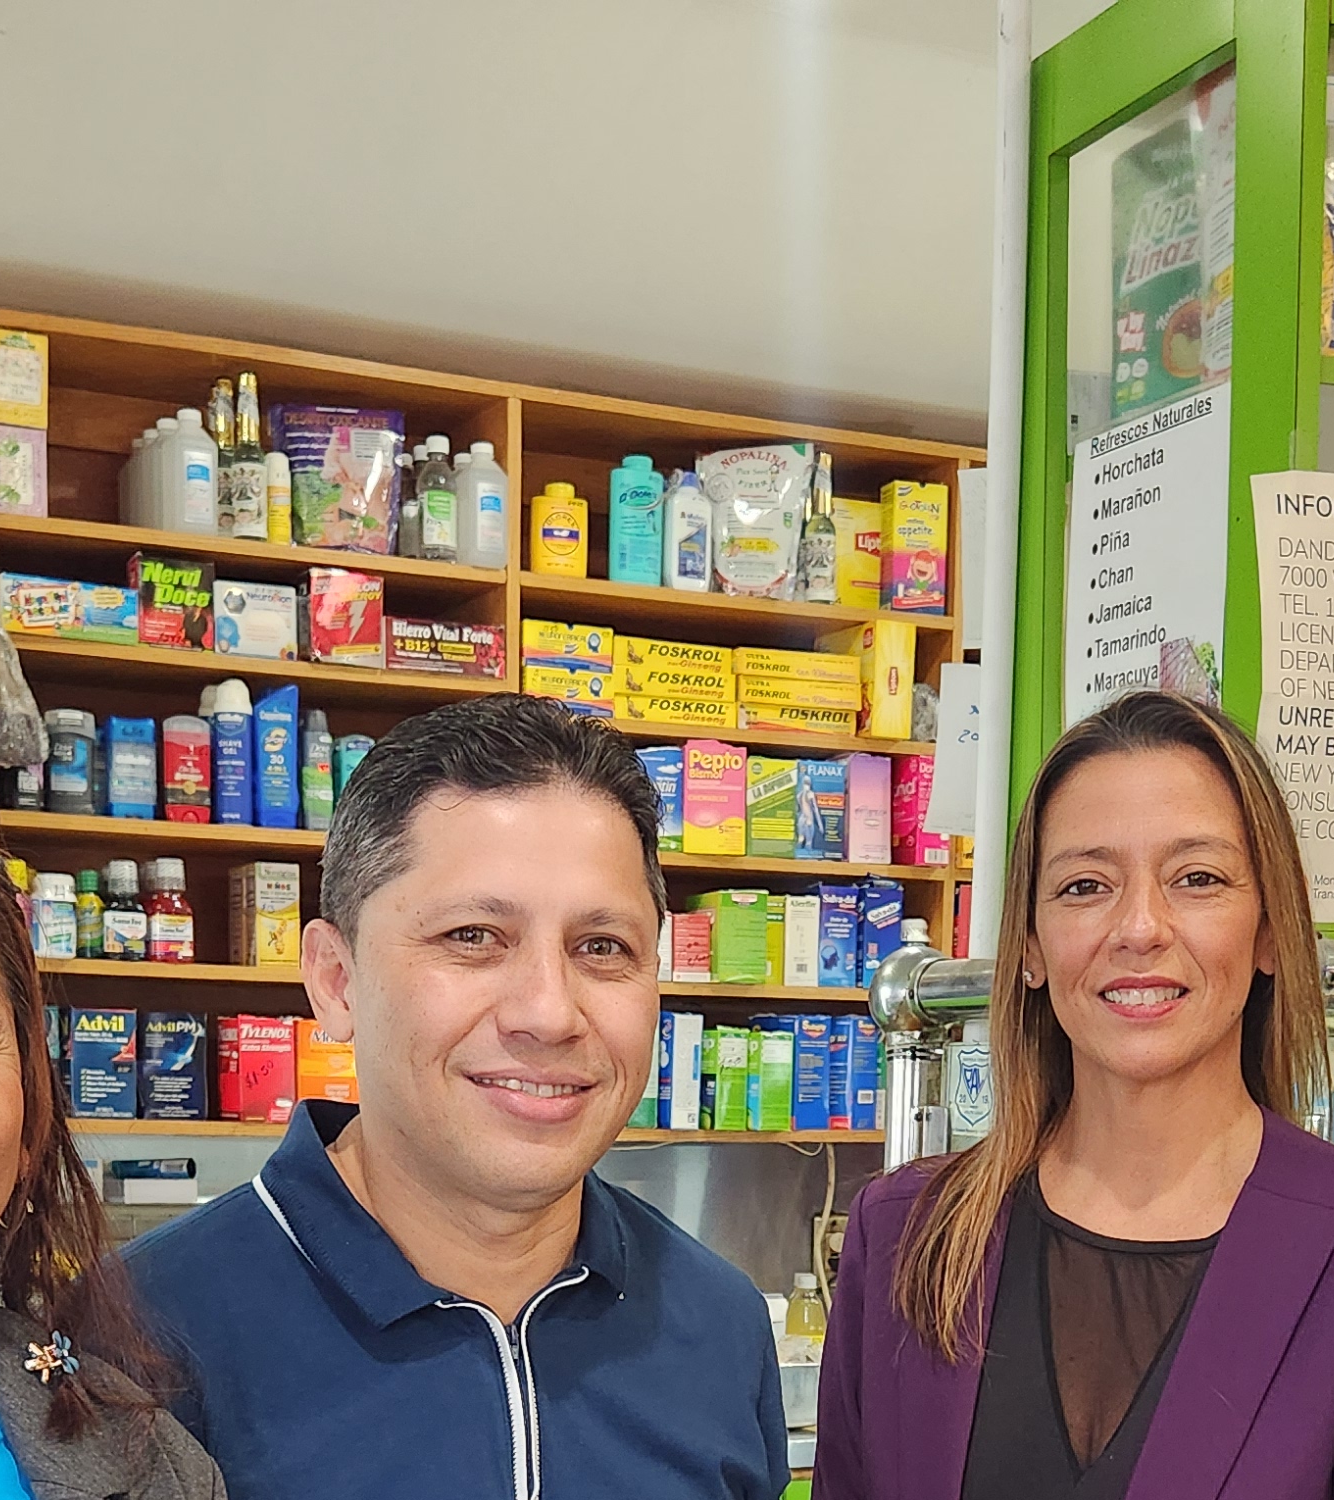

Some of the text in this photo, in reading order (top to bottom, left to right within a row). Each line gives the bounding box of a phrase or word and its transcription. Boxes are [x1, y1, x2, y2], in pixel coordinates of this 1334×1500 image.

[1090, 395, 1213, 458] Refrescos Naturales
[720, 449, 789, 471] NOPALINA
[1102, 447, 1165, 486] Horchata
[1100, 485, 1161, 521] Marañon
[1100, 530, 1130, 556] Piña
[1098, 564, 1134, 590] Chan
[1279, 565, 1328, 589] 7000
[156, 583, 211, 608] Doce
[1279, 593, 1319, 617] TEL.
[1095, 594, 1153, 626] Jamaica
[392, 619, 495, 646] Hierro Vital Forte
[1094, 624, 1167, 659] Tamarindo
[648, 643, 723, 663] FOSKROL
[746, 661, 791, 674] FOSKROL
[1093, 663, 1159, 694] Maracuya
[647, 671, 725, 689] FOSKROL
[1280, 677, 1307, 698] OF
[745, 688, 791, 701] FOSKROL
[648, 698, 727, 716] FOSKROL
[779, 707, 852, 725] FOSKROL
[1275, 733, 1321, 756] MAY
[269, 754, 284, 765] 30
[689, 748, 743, 774] Pepto
[808, 764, 844, 777] FLANAX
[689, 767, 724, 780] Bismol
[1275, 762, 1323, 784] NEW
[75, 1014, 125, 1033] Advil
[240, 1023, 292, 1039] TYLENOL
